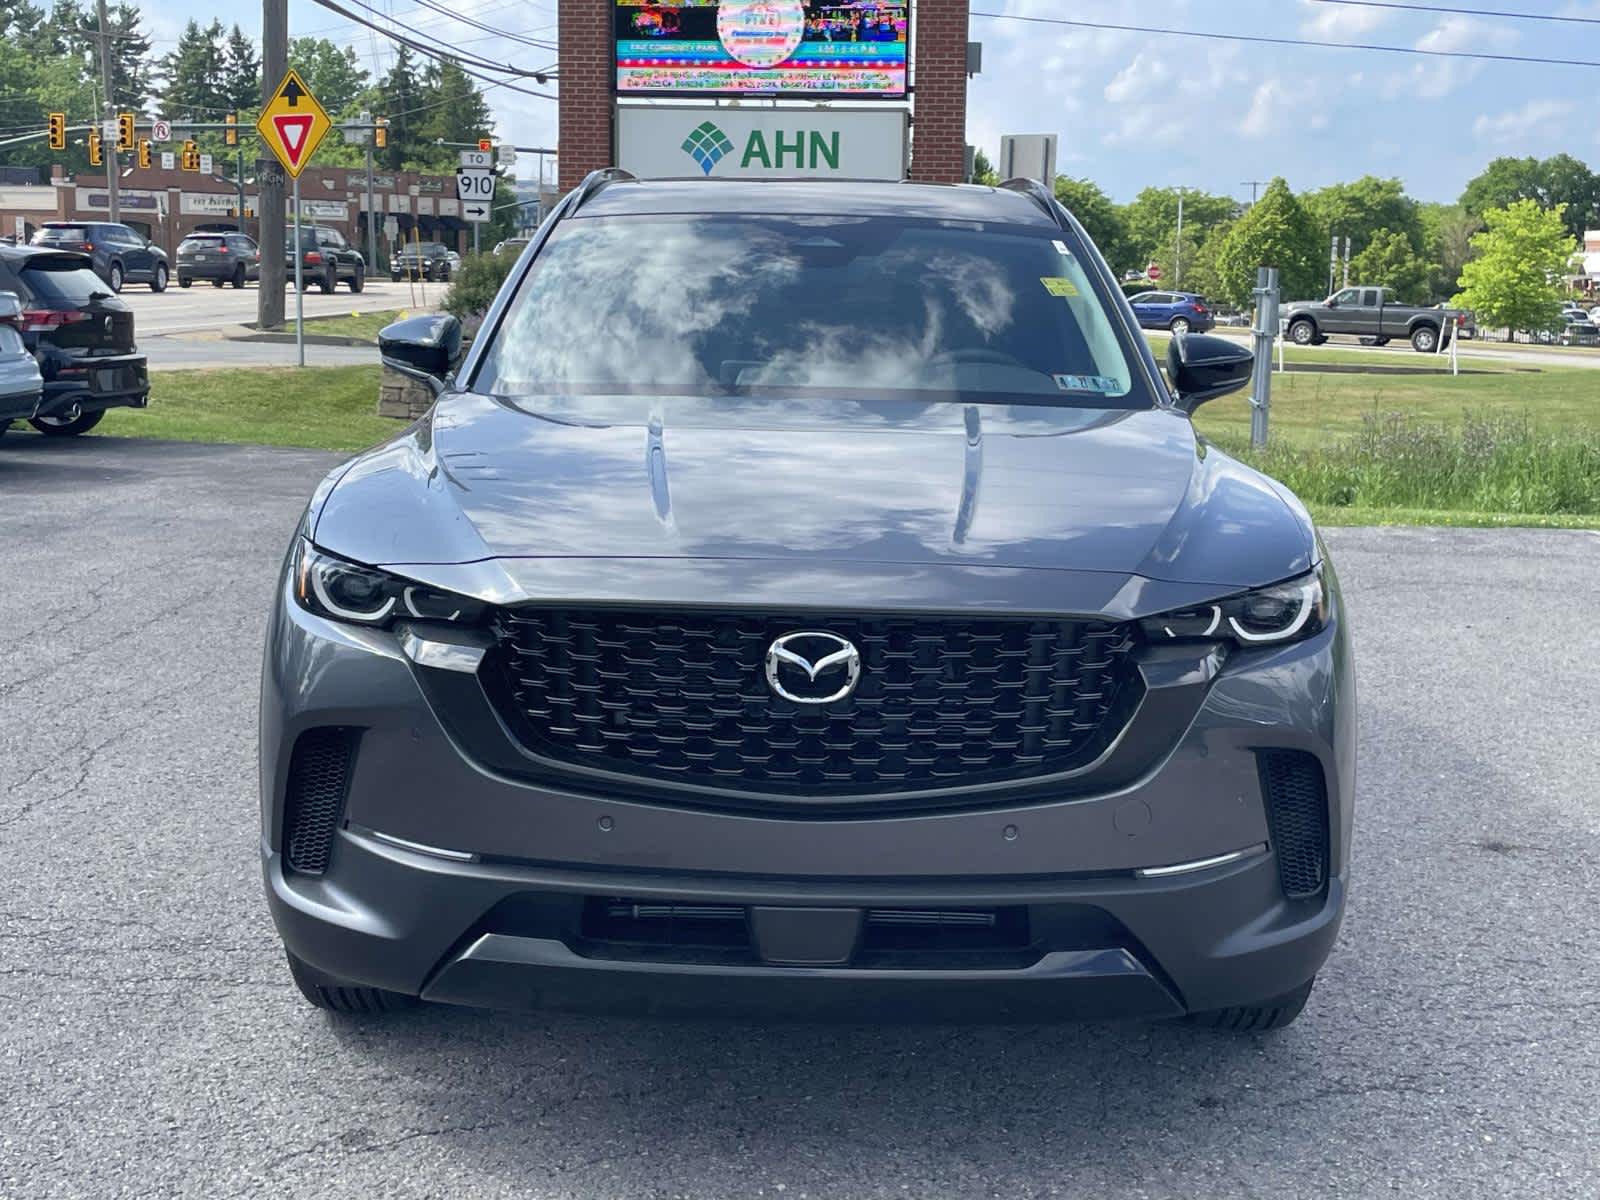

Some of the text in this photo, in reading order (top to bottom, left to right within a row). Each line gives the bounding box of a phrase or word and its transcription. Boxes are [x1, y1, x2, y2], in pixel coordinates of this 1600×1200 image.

[740, 129, 840, 169] AHN
[469, 154, 484, 164] TO
[460, 176, 492, 194] 910
